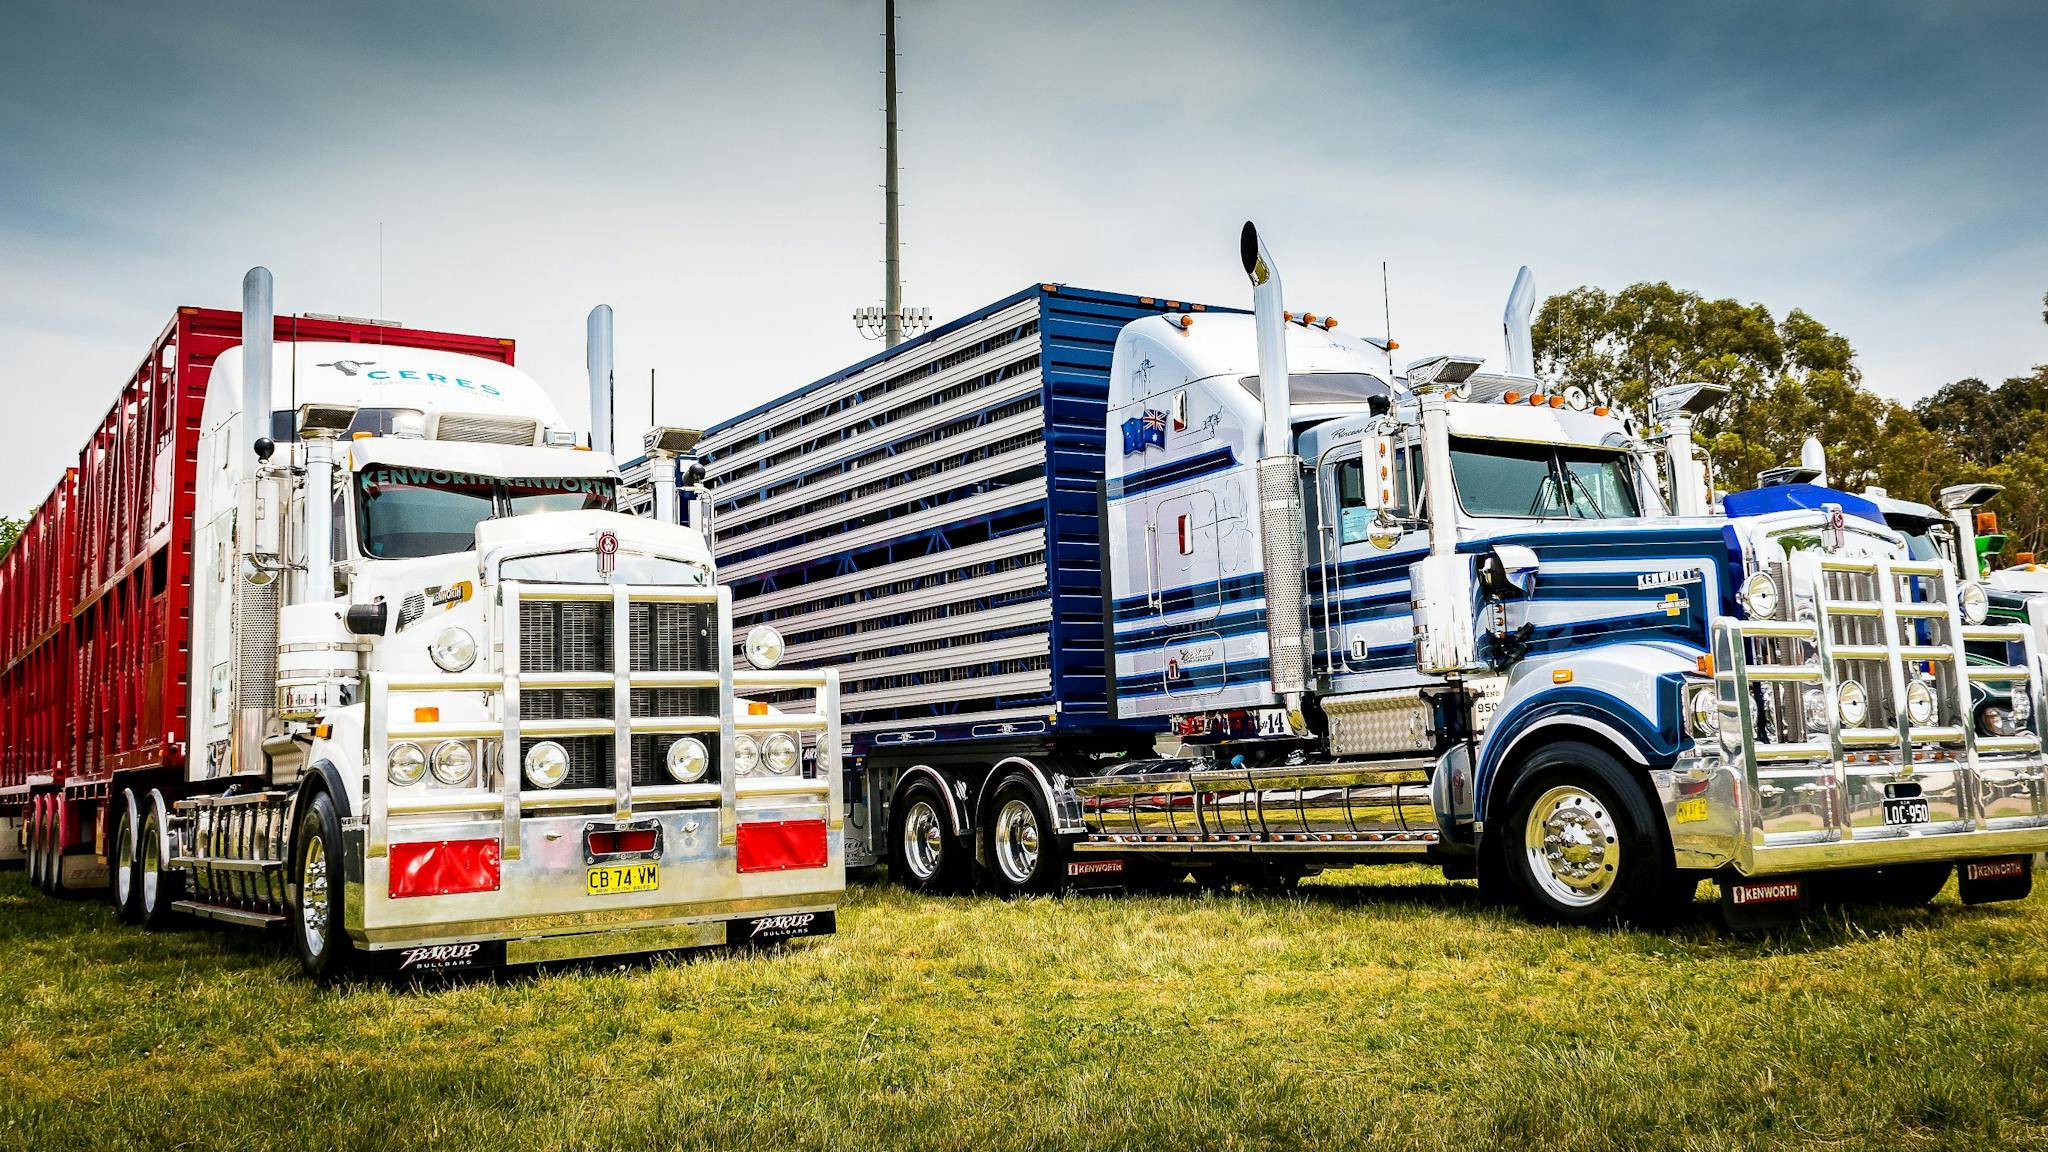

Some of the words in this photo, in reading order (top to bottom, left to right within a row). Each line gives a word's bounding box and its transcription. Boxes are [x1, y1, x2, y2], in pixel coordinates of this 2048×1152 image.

[367, 371, 500, 396] CERES
[360, 470, 495, 490] KENWORTH
[500, 477, 613, 500] KENWORTH
[1078, 863, 1122, 873] KENWORTH
[1977, 863, 2023, 877] KENWORTH
[1745, 884, 1797, 900] KENWORTH
[763, 928, 809, 937] BULLBARS
[416, 959, 472, 970] BULLBARS
